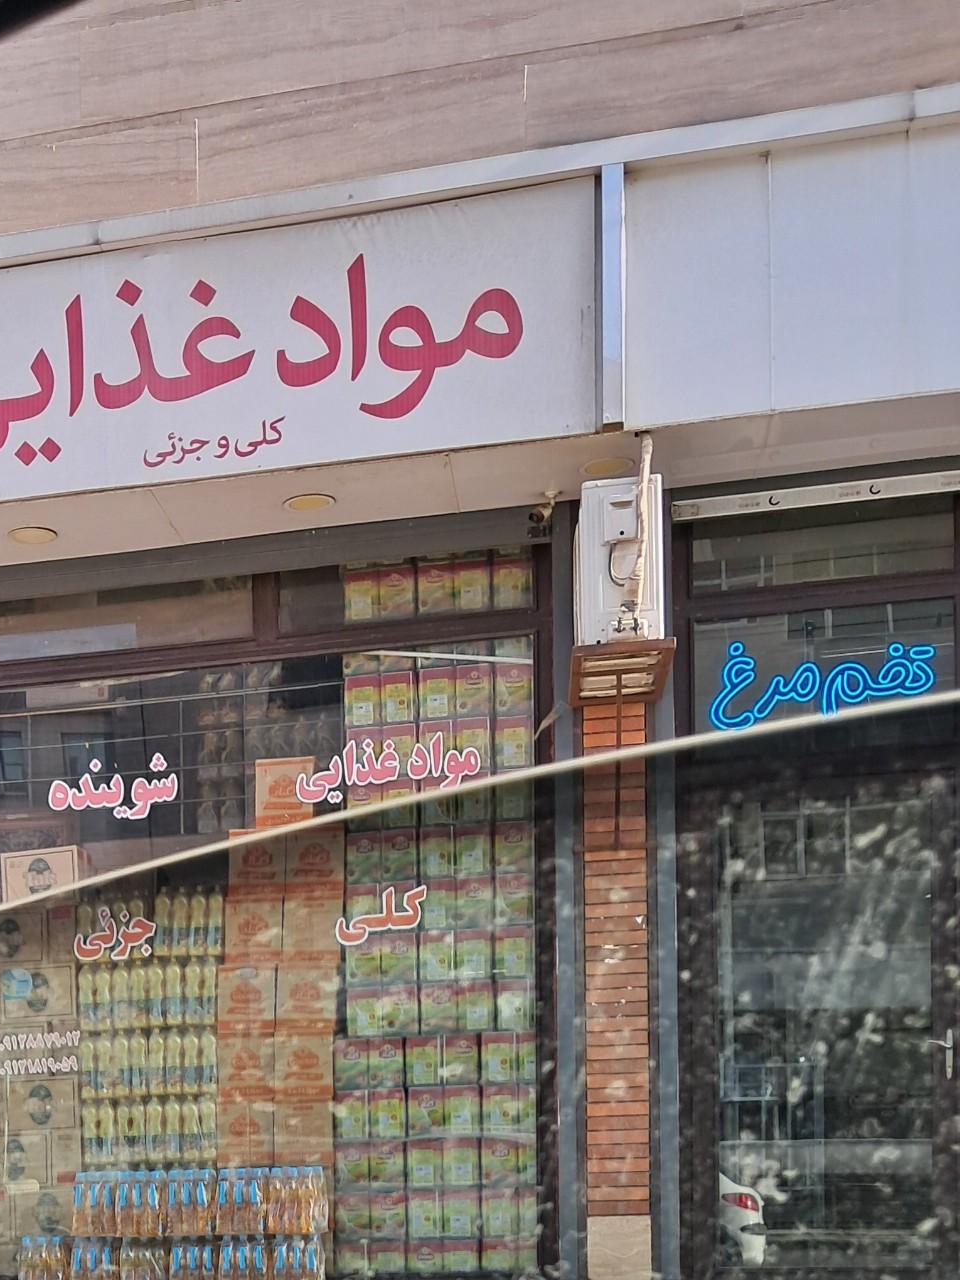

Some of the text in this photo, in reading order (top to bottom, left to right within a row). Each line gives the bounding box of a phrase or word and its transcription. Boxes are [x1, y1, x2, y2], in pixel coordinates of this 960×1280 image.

[275, 253, 524, 418] مواد
[143, 415, 286, 468] کلی و جزئی
[708, 640, 936, 732] تخم مرغ
[47, 752, 178, 820] شوینده
[295, 732, 481, 804] مواد غذایی
[73, 906, 157, 961] جزئی
[335, 884, 428, 945] کلی
